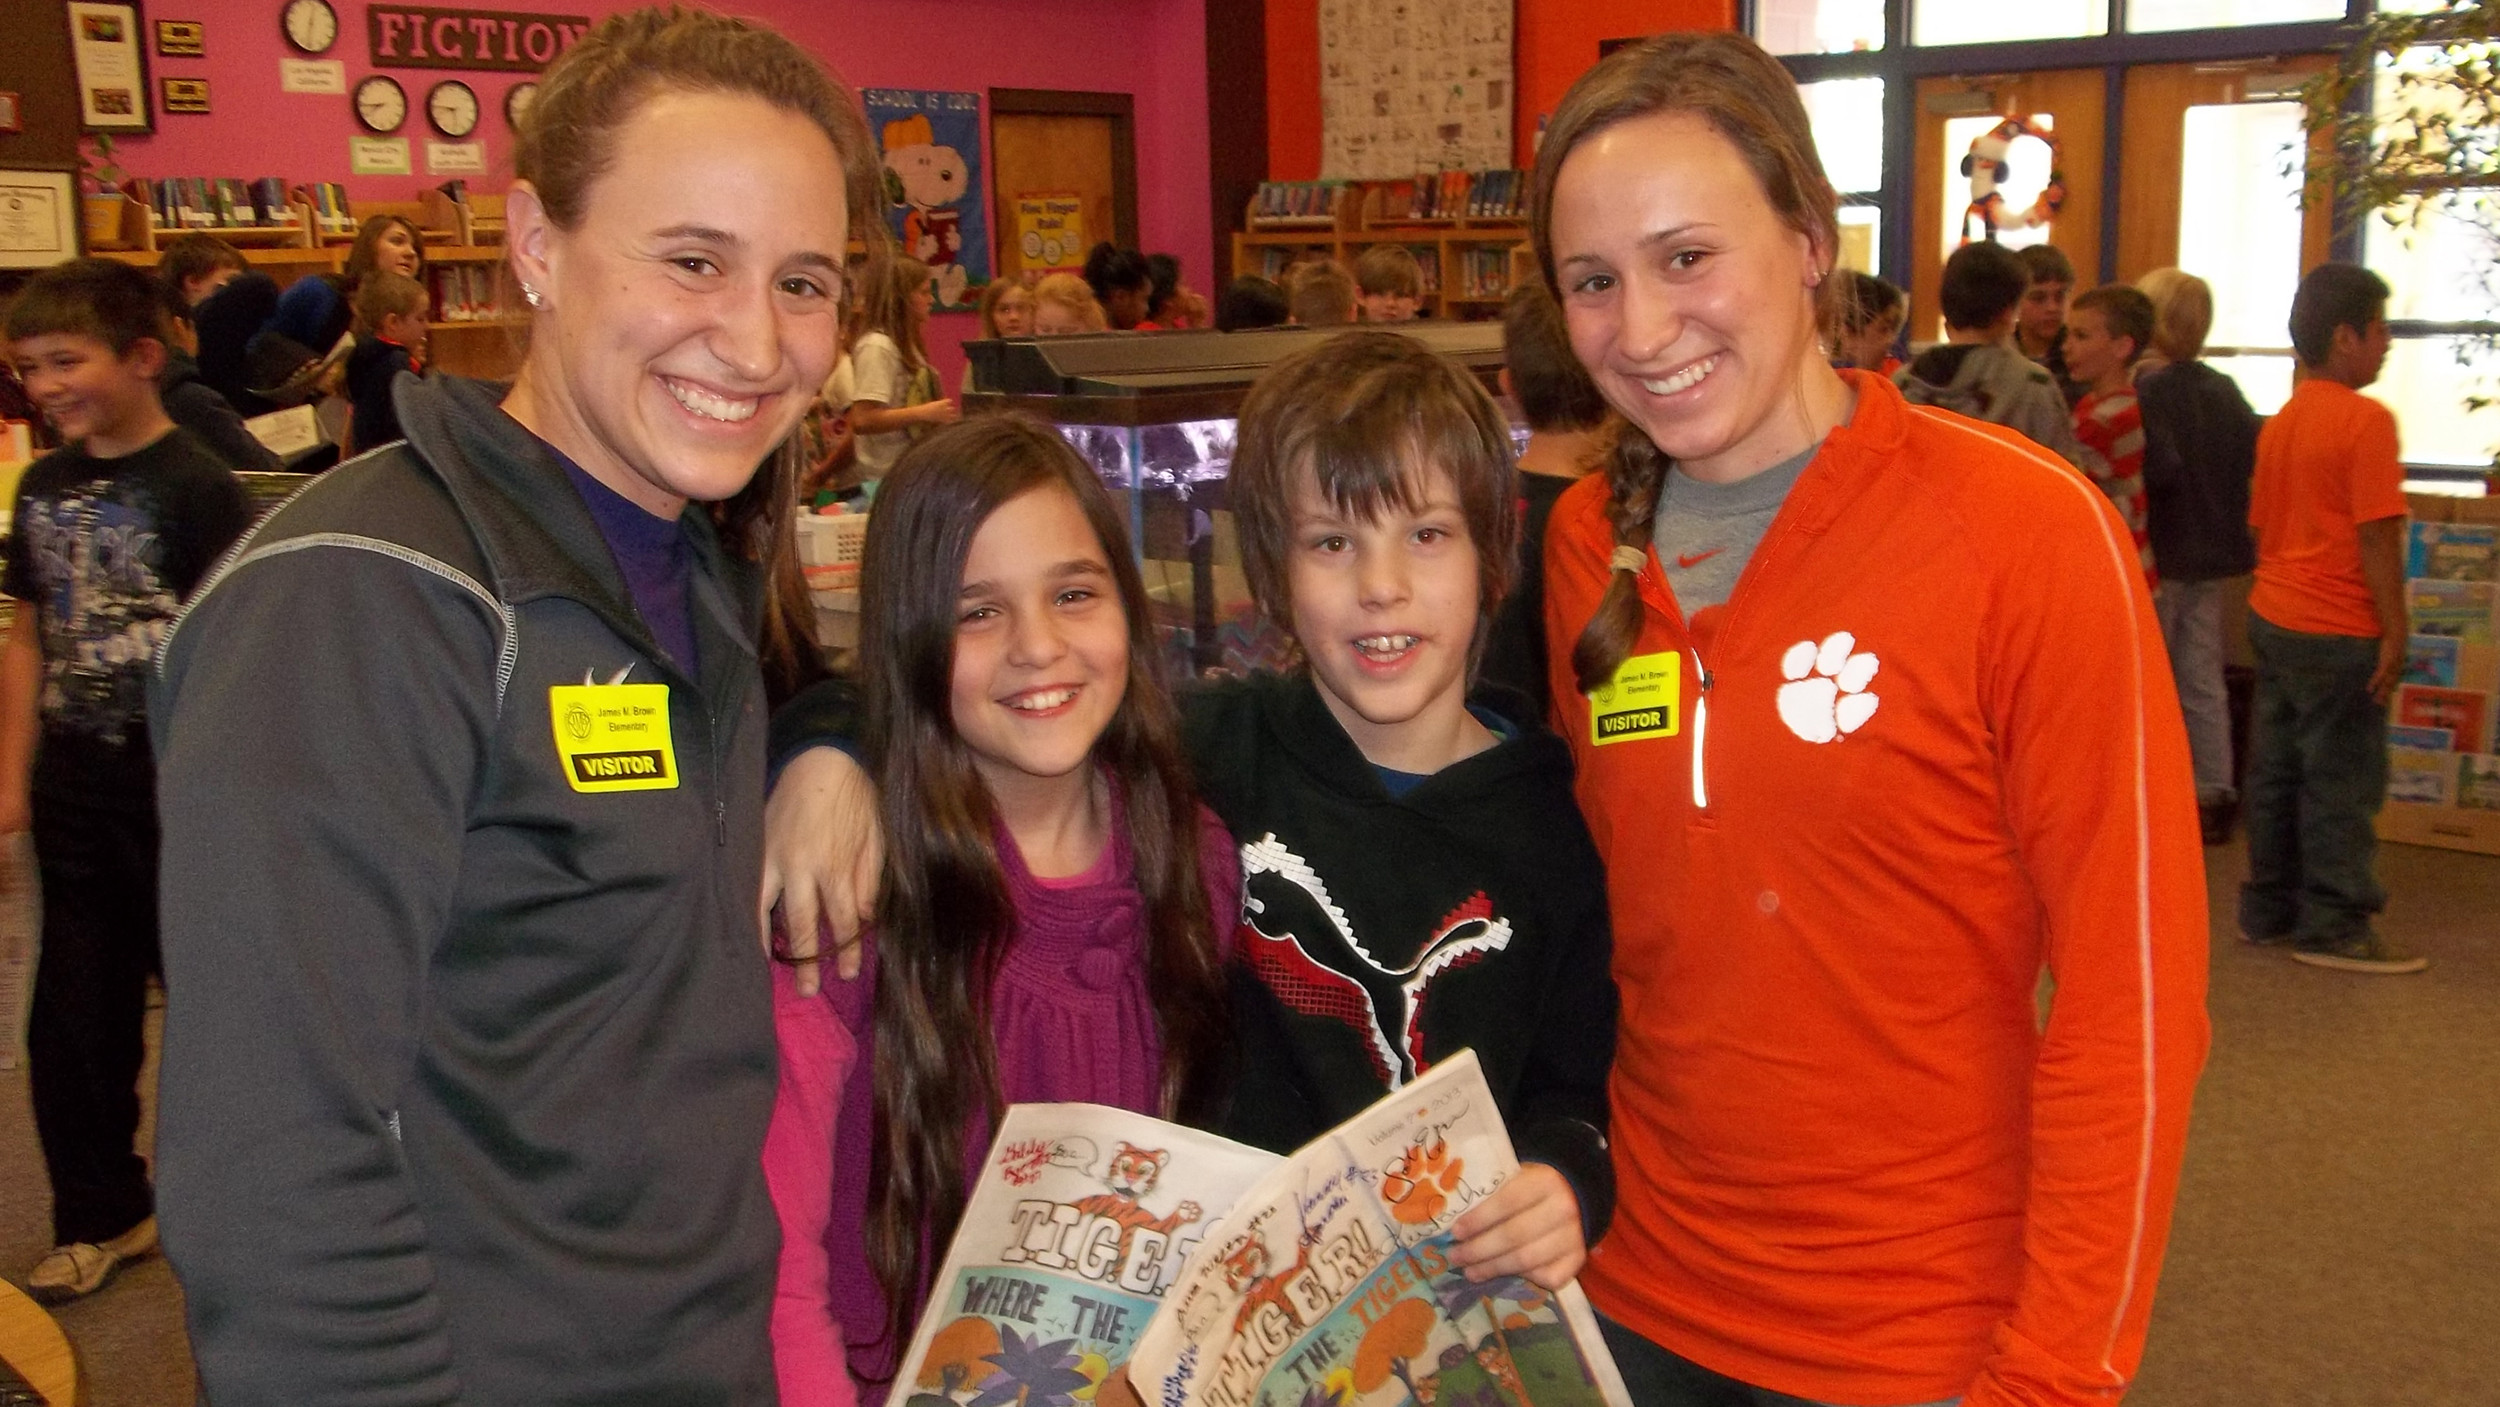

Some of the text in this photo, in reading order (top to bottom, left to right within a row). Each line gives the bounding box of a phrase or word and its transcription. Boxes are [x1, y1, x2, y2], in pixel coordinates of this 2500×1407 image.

[376, 13, 588, 64] FICTION
[867, 89, 918, 109] SCHOOL
[925, 93, 940, 110] IS
[1620, 674, 1640, 683] James
[1649, 670, 1670, 680] Brown
[1627, 684, 1661, 695] Elementary
[598, 707, 622, 718] James
[633, 705, 657, 717] Brown
[1604, 711, 1661, 733] VISITOR
[608, 721, 649, 733] Elementary
[581, 756, 658, 777] VISITOR
[961, 1275, 1050, 1325] WHERE
[1071, 1294, 1130, 1345] THE
[1282, 1328, 1342, 1386] THE
